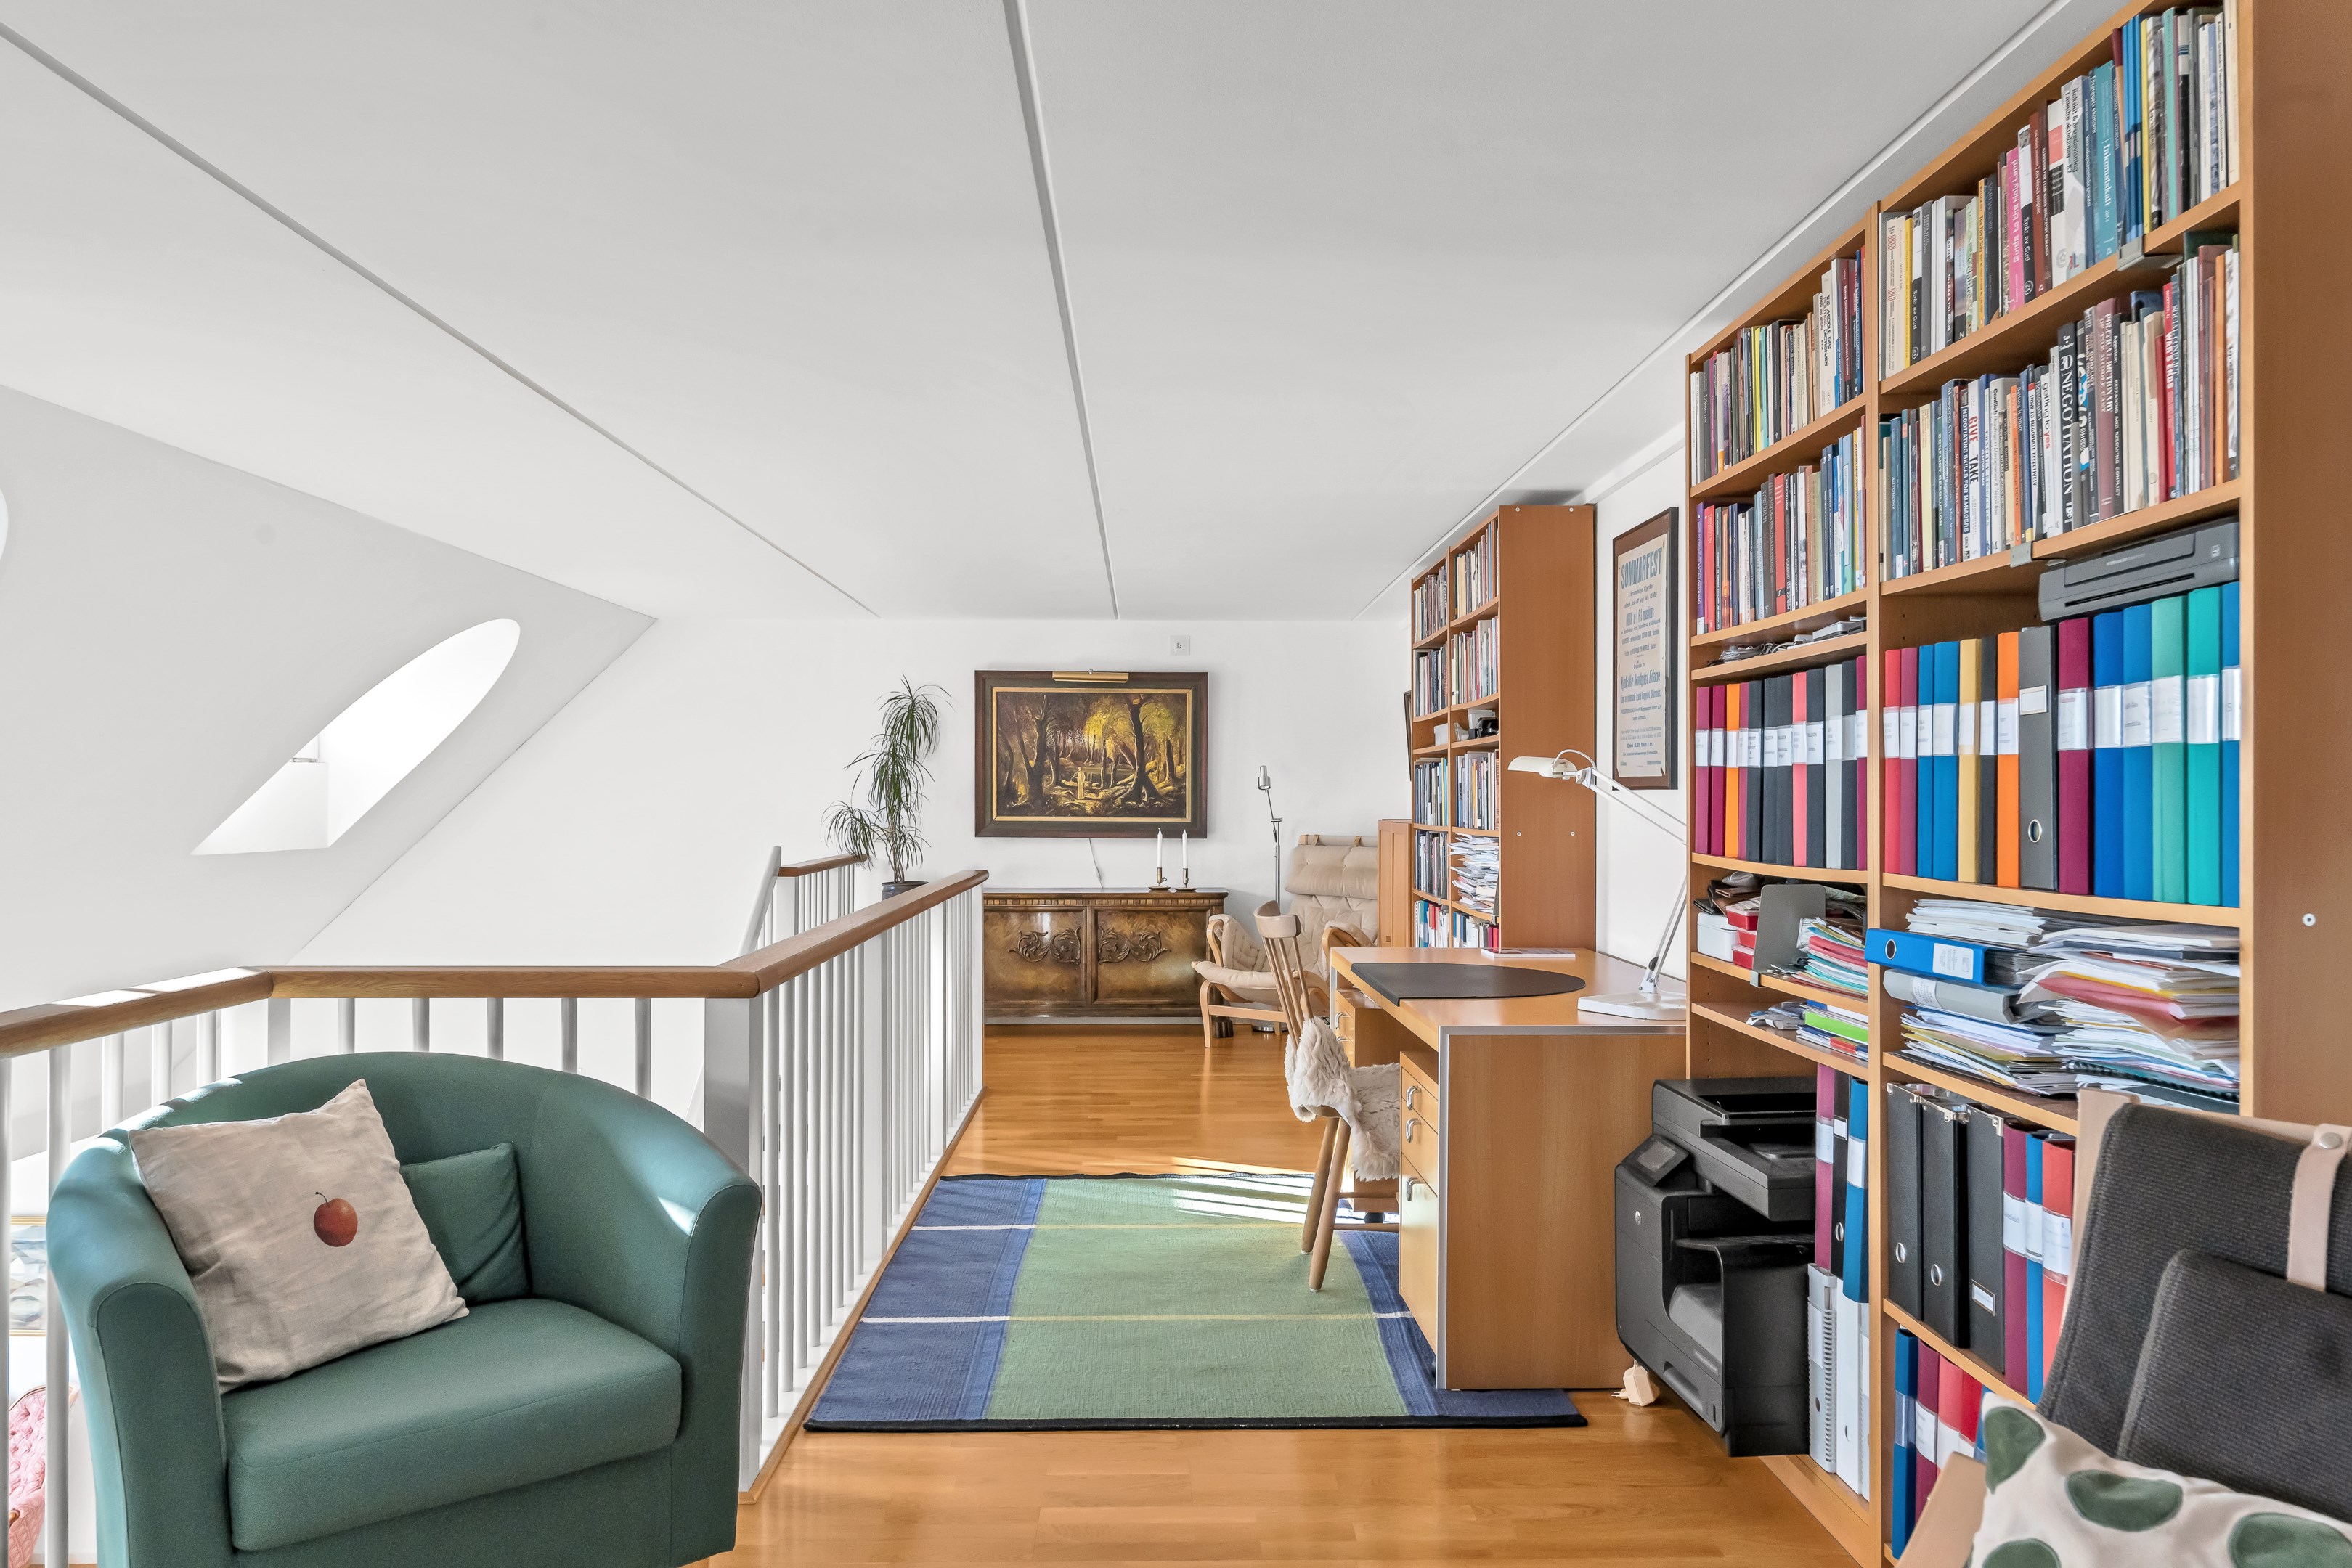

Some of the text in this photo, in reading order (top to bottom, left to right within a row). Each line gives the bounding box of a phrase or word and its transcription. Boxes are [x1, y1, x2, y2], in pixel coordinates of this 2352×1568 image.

[2103, 144, 2112, 206] Inkomstskatt
[2013, 221, 2019, 233] to
[2025, 236, 2029, 245] av
[2165, 330, 2174, 390] WAR'S ENDS
[2041, 382, 2051, 419] getting
[2044, 420, 2051, 430] to
[2060, 372, 2072, 495] NEGOTIATION
[1969, 415, 1979, 484] GIVE TAKE
[1621, 547, 1662, 589] SOMMARFEST
